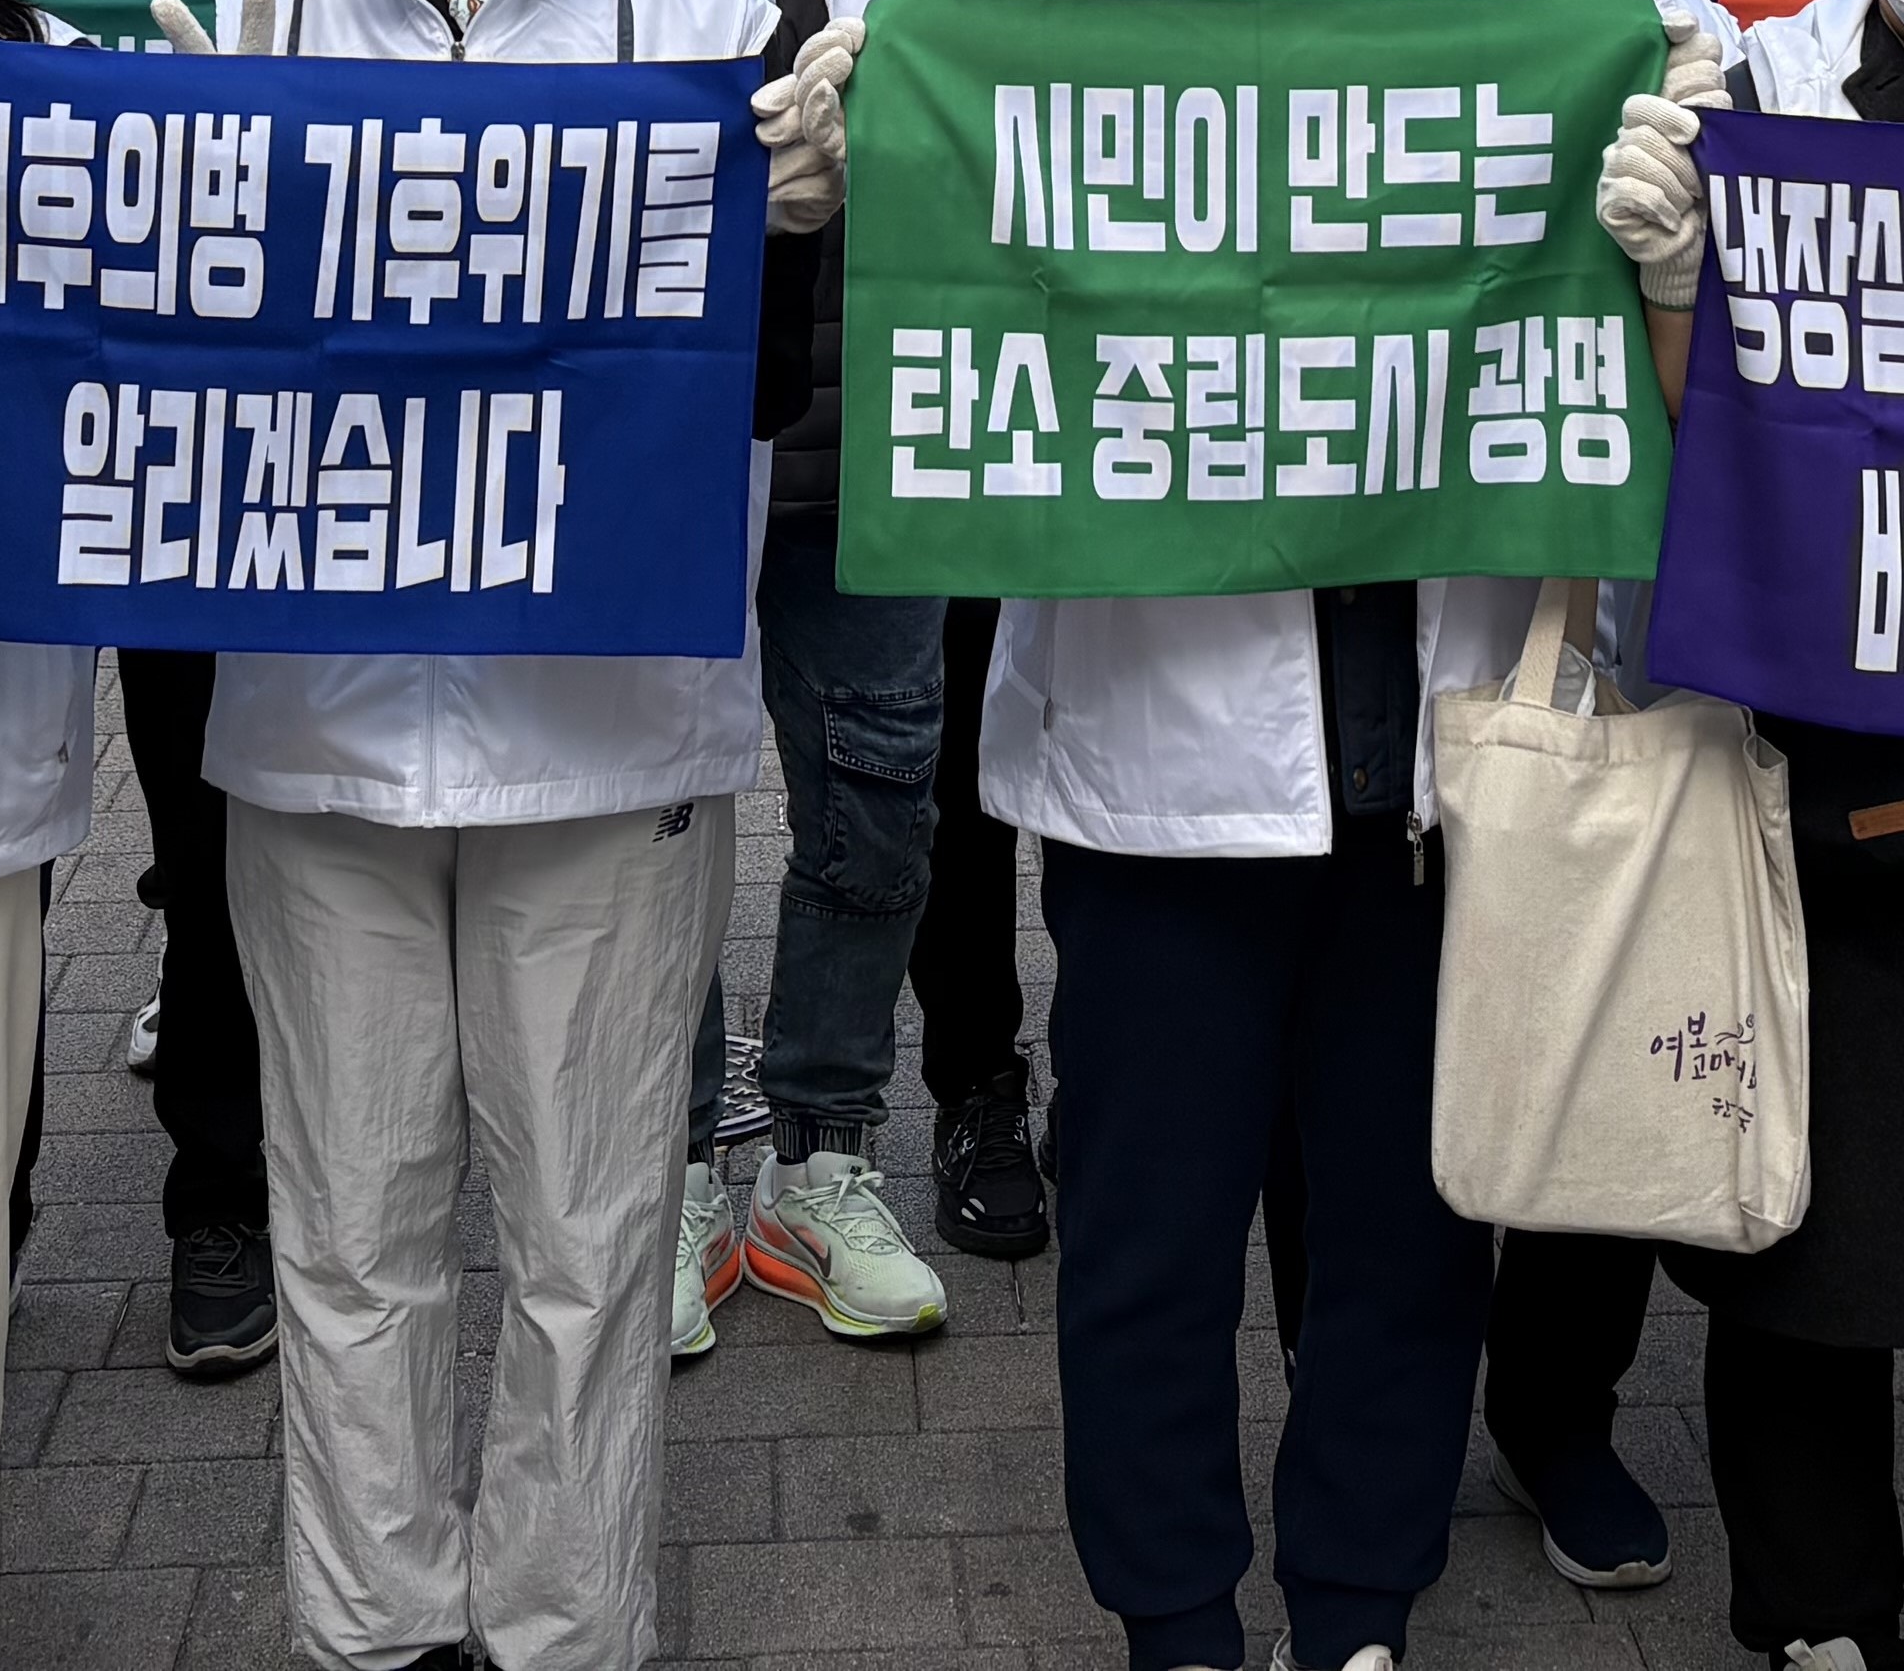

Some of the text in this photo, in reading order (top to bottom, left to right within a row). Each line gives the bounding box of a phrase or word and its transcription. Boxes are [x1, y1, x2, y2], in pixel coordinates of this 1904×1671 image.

[304, 115, 720, 325] 기후위기를
[990, 81, 1556, 257] 시민이 만드는
[54, 379, 567, 597] 알리겠습니다
[888, 315, 1633, 503] 탄소 중립도시 광명
